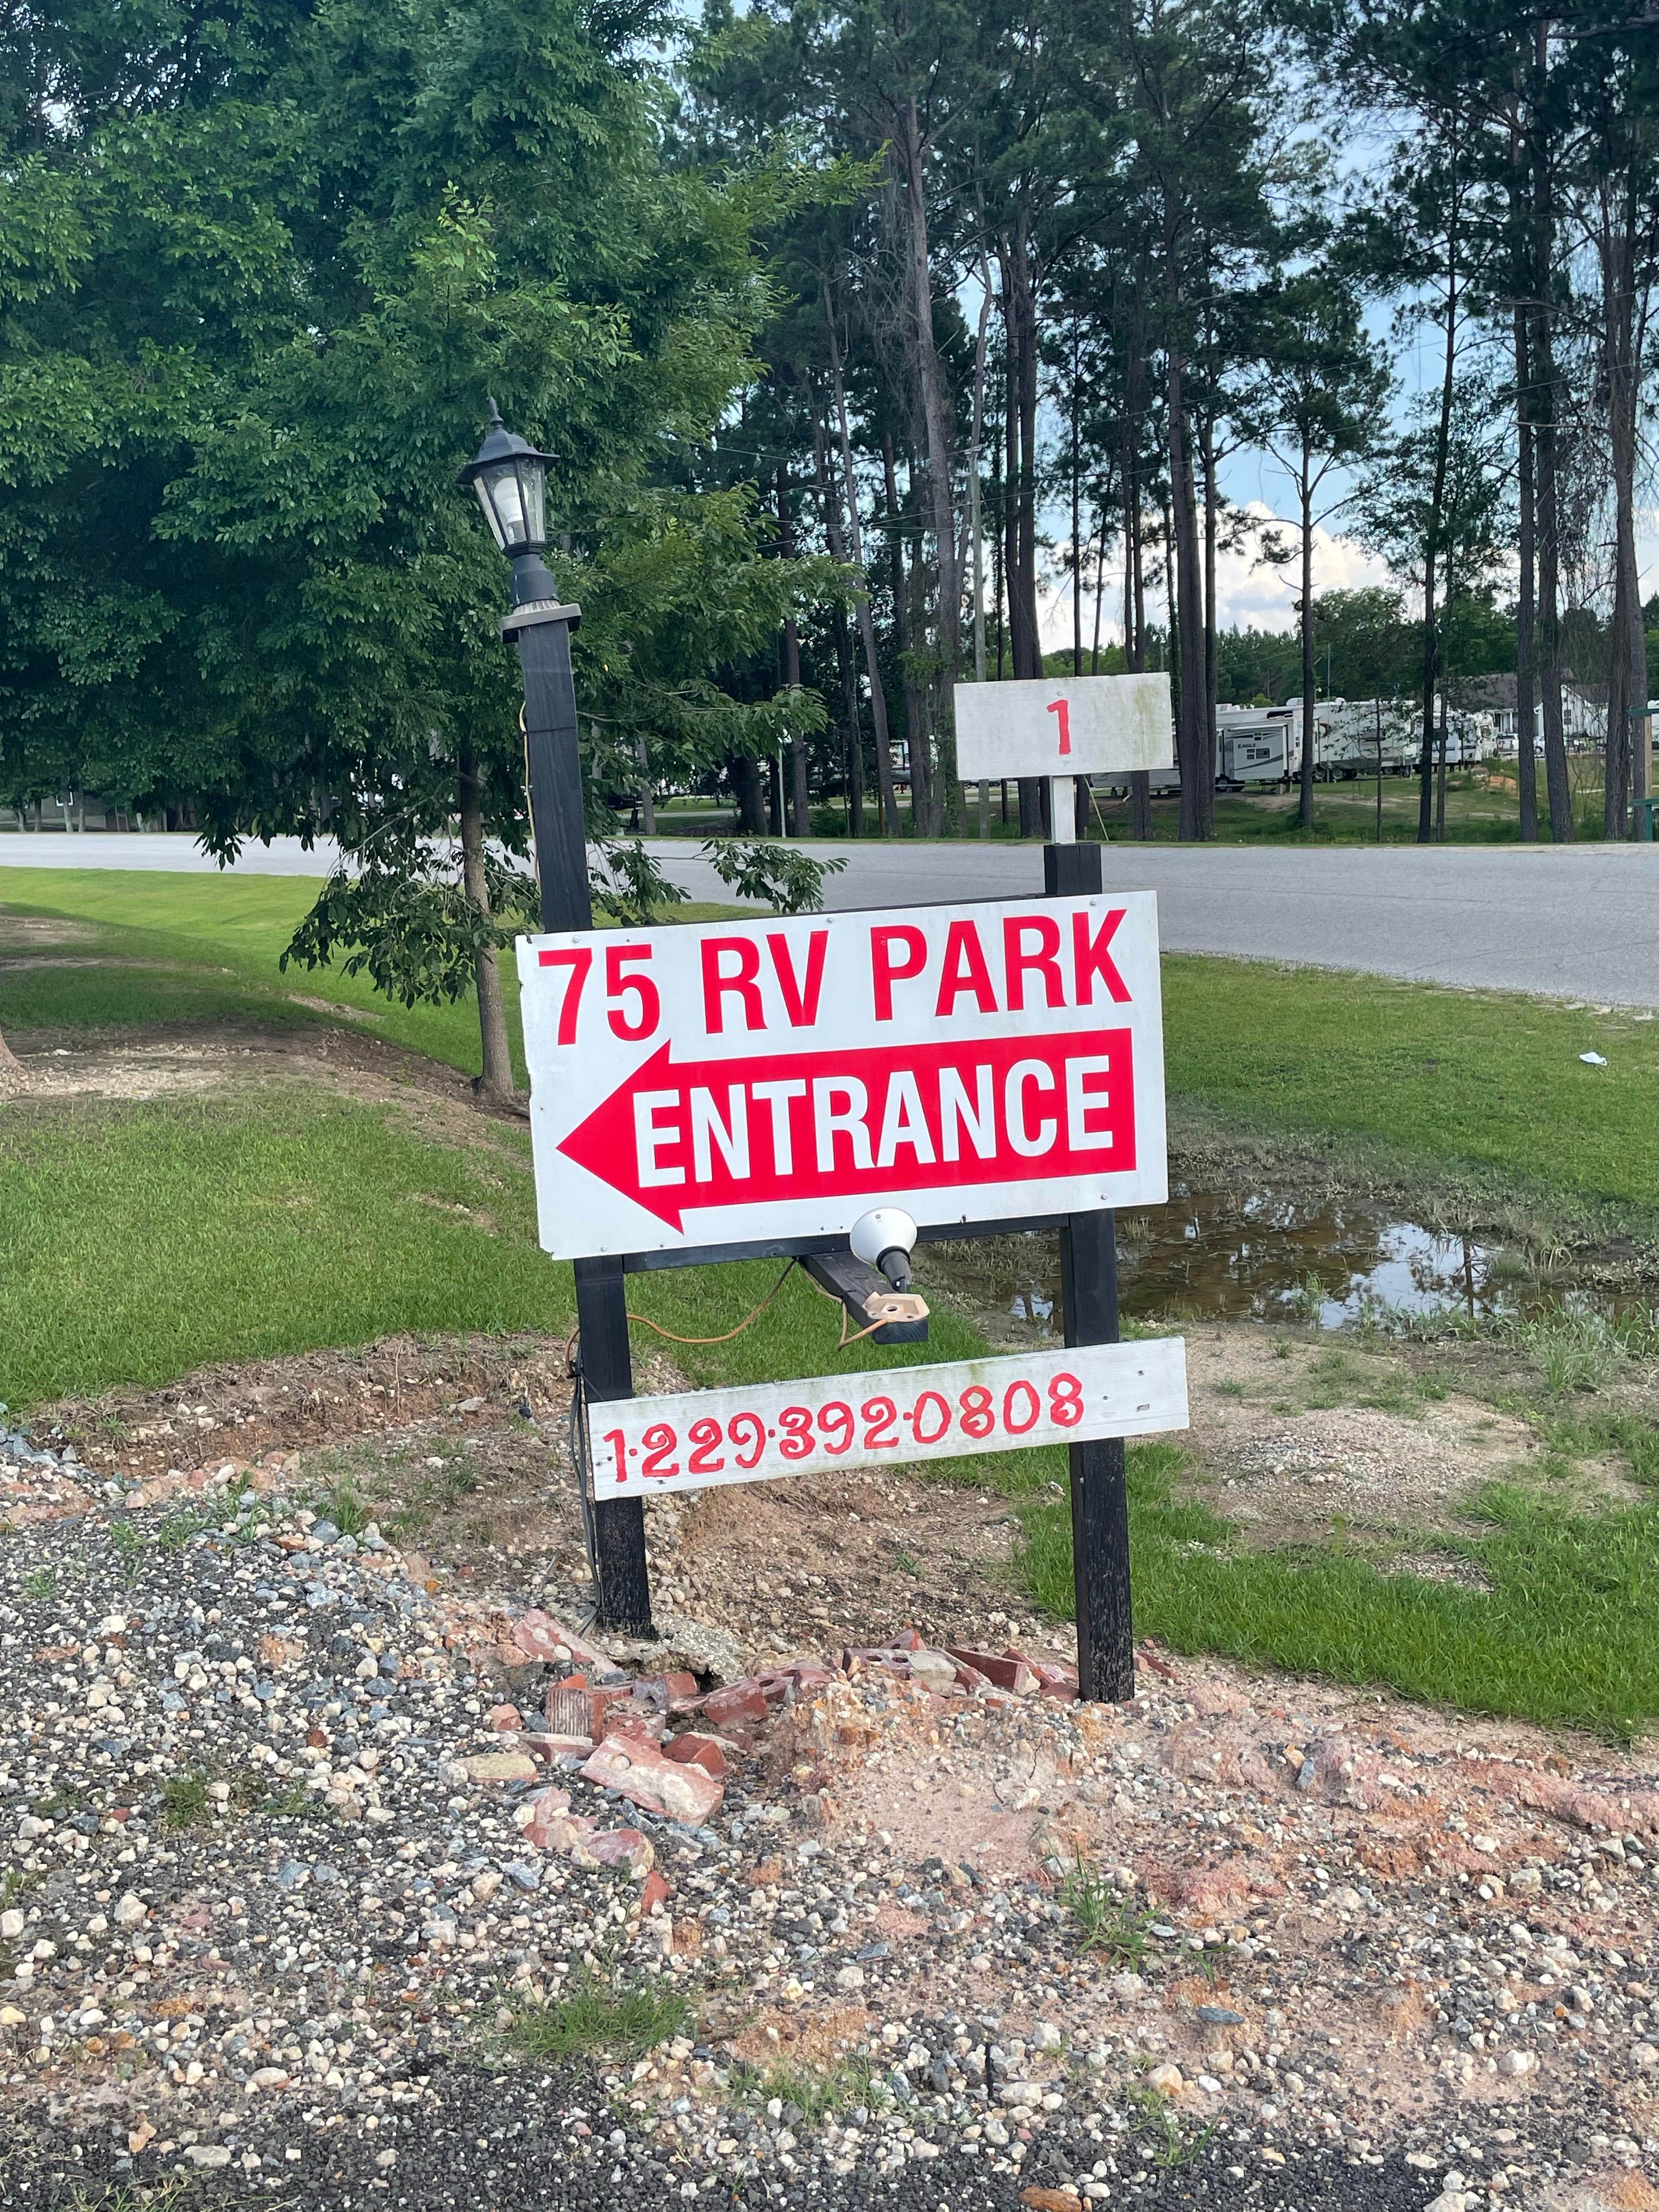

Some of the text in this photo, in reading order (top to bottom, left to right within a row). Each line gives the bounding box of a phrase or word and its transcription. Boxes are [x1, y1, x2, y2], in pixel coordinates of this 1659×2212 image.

[1046, 699, 1071, 755] 1
[538, 909, 1133, 1046] 75 RV PARK
[632, 1054, 1114, 1188] ENTRANCE
